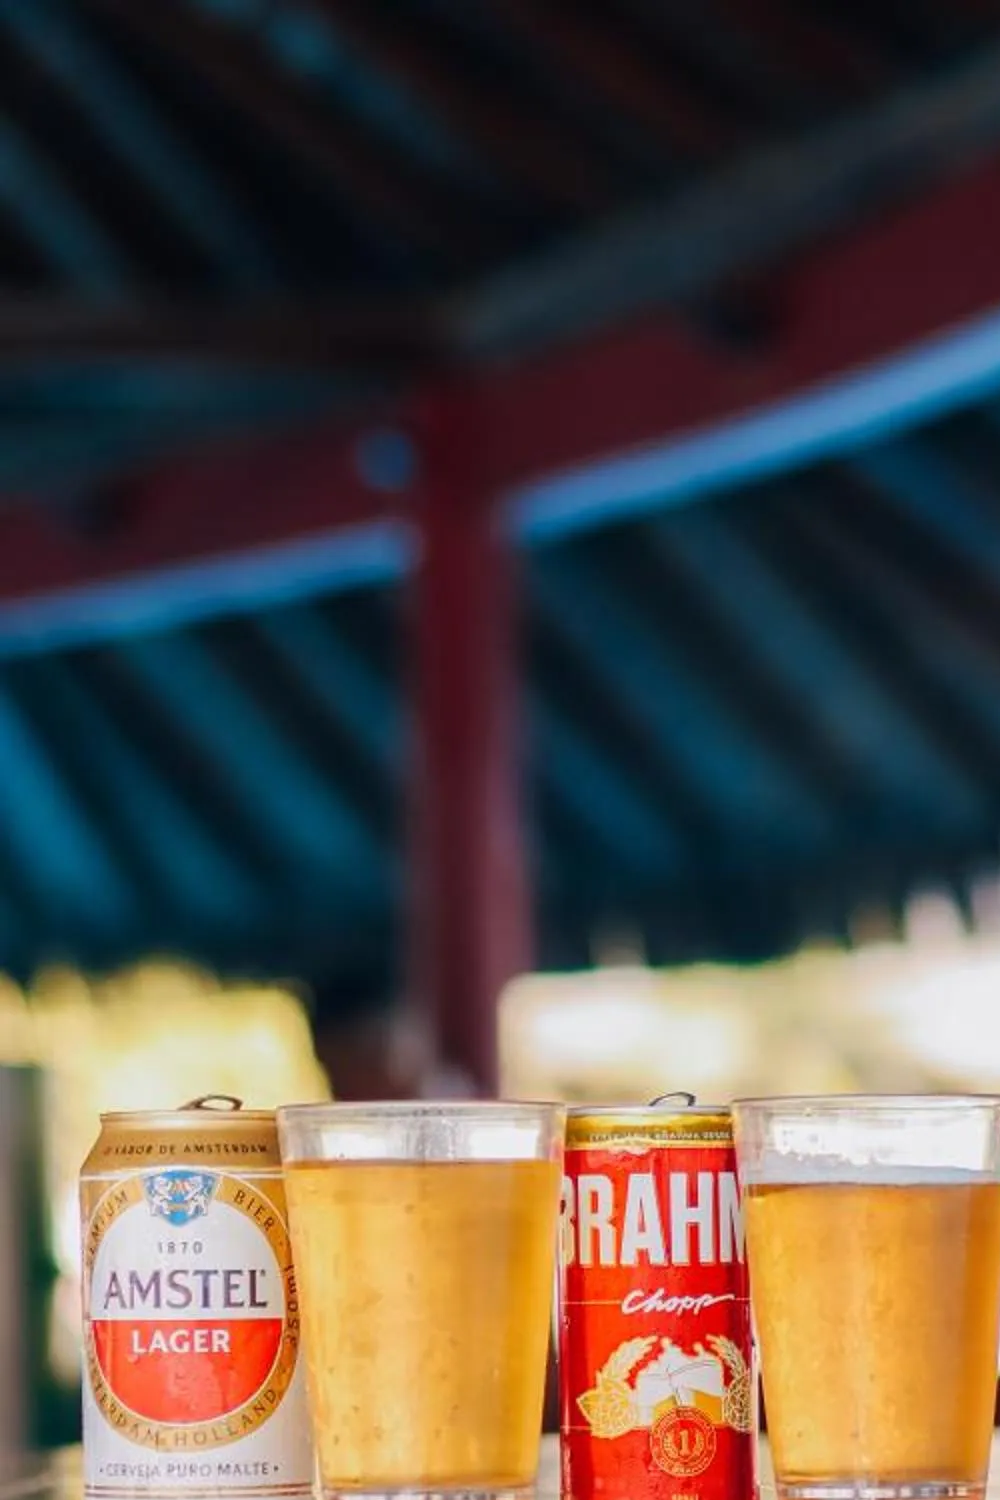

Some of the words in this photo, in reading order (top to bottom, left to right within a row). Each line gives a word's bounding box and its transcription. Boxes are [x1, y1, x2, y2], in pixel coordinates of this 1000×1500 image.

[233, 1190, 275, 1233] BIER
[158, 1240, 204, 1255] 1870
[103, 1268, 269, 1311] AMSTEL
[621, 1287, 736, 1315] Chopp
[131, 1328, 232, 1354] LAGER
[174, 1388, 278, 1448] HOLLAND
[106, 1462, 162, 1478] CERVEJA
[166, 1463, 213, 1478] PURO
[217, 1462, 269, 1476] MALTE
